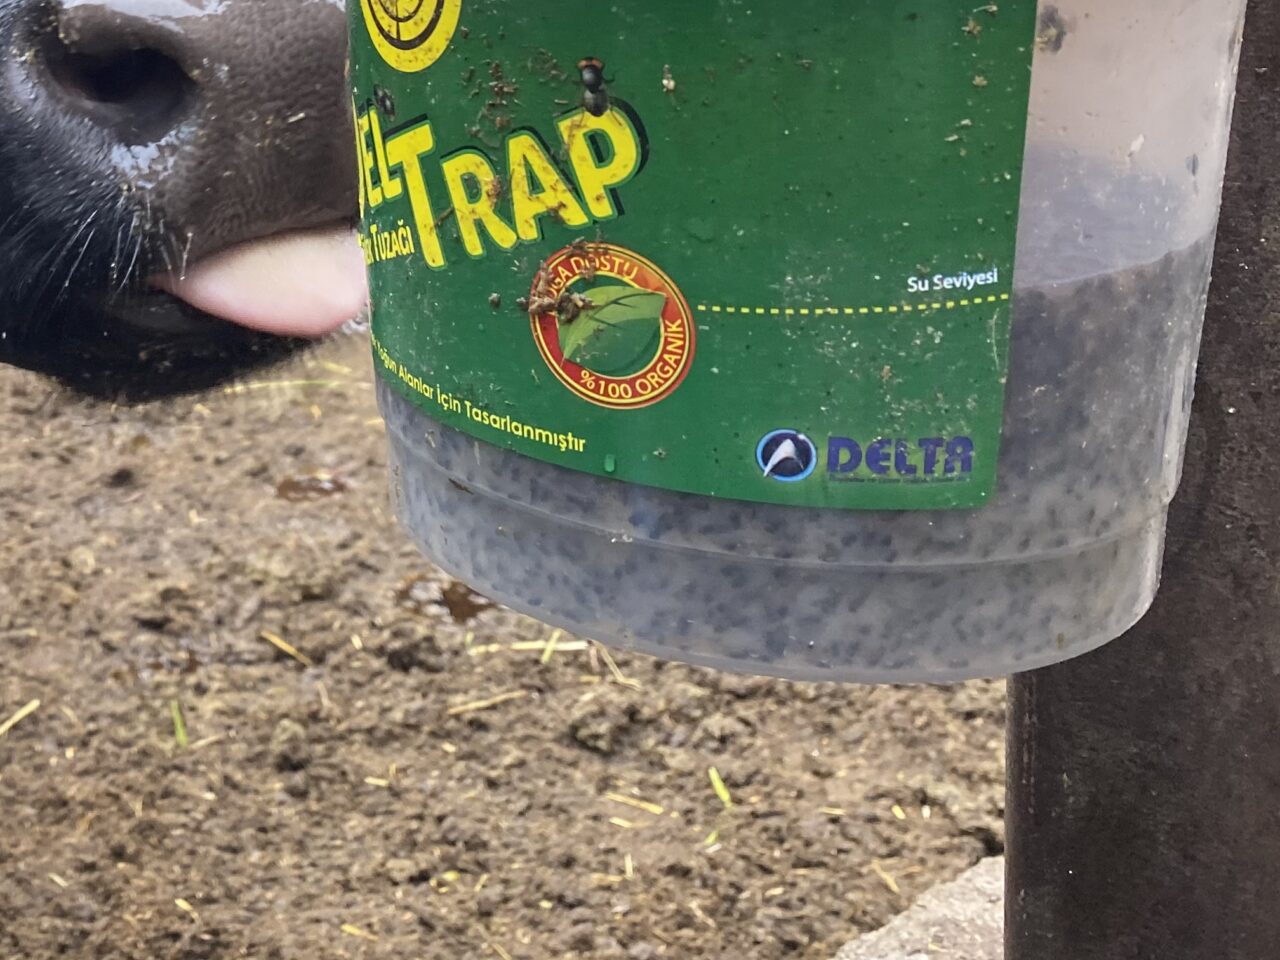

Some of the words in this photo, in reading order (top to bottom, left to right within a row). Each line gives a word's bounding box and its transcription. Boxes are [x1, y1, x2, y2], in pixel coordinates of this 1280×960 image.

[352, 95, 641, 269] ELTRAP
[907, 276, 930, 293] Su
[932, 267, 998, 291] Seviyesi
[581, 369, 633, 399] %100
[635, 319, 685, 395] ORGANİK
[398, 364, 434, 399] Alanlar
[436, 383, 461, 414] İçin
[464, 400, 586, 452] Tasarlanmıştır
[827, 436, 974, 475] DELTA
